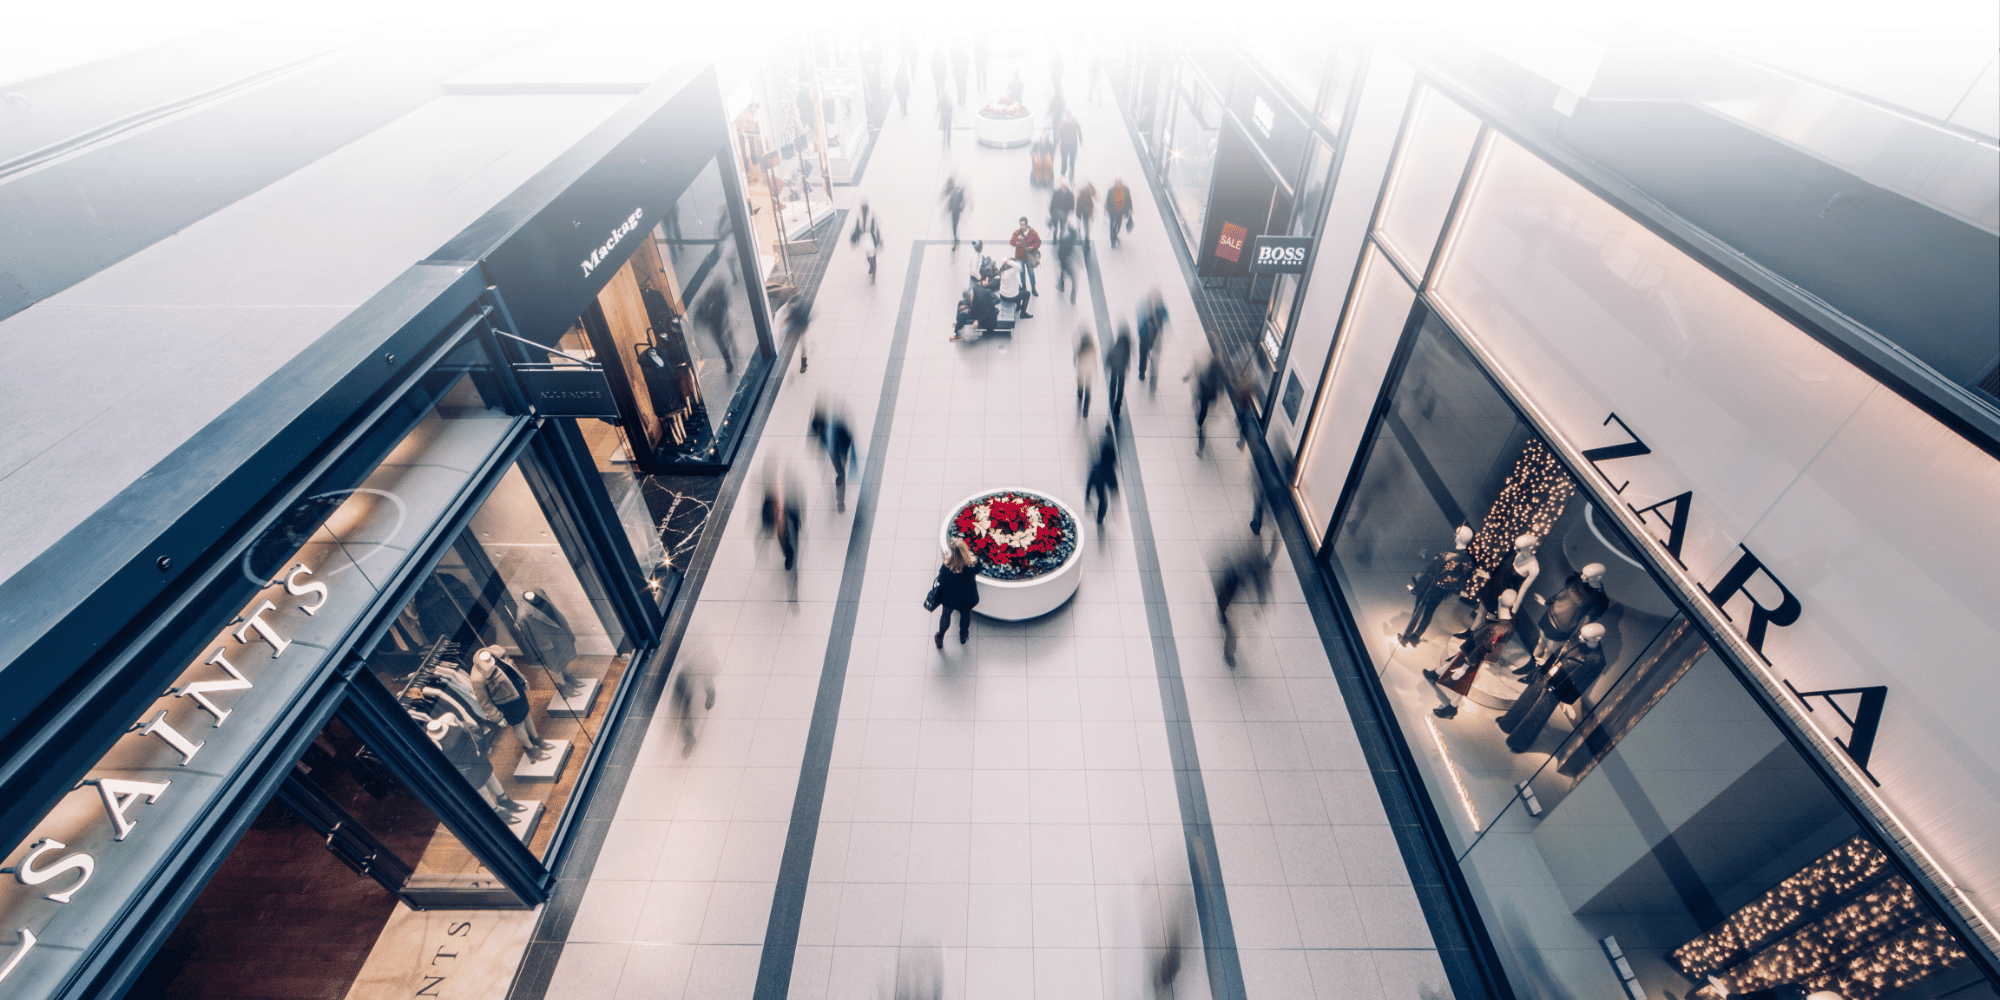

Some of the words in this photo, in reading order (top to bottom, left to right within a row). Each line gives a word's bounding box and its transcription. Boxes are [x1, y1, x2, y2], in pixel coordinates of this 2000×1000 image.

[581, 207, 643, 278] Mackage
[1220, 235, 1242, 250] SALE
[1258, 246, 1306, 261] BOSS
[654, 491, 683, 547] ackage
[1582, 412, 1888, 788] ZARA
